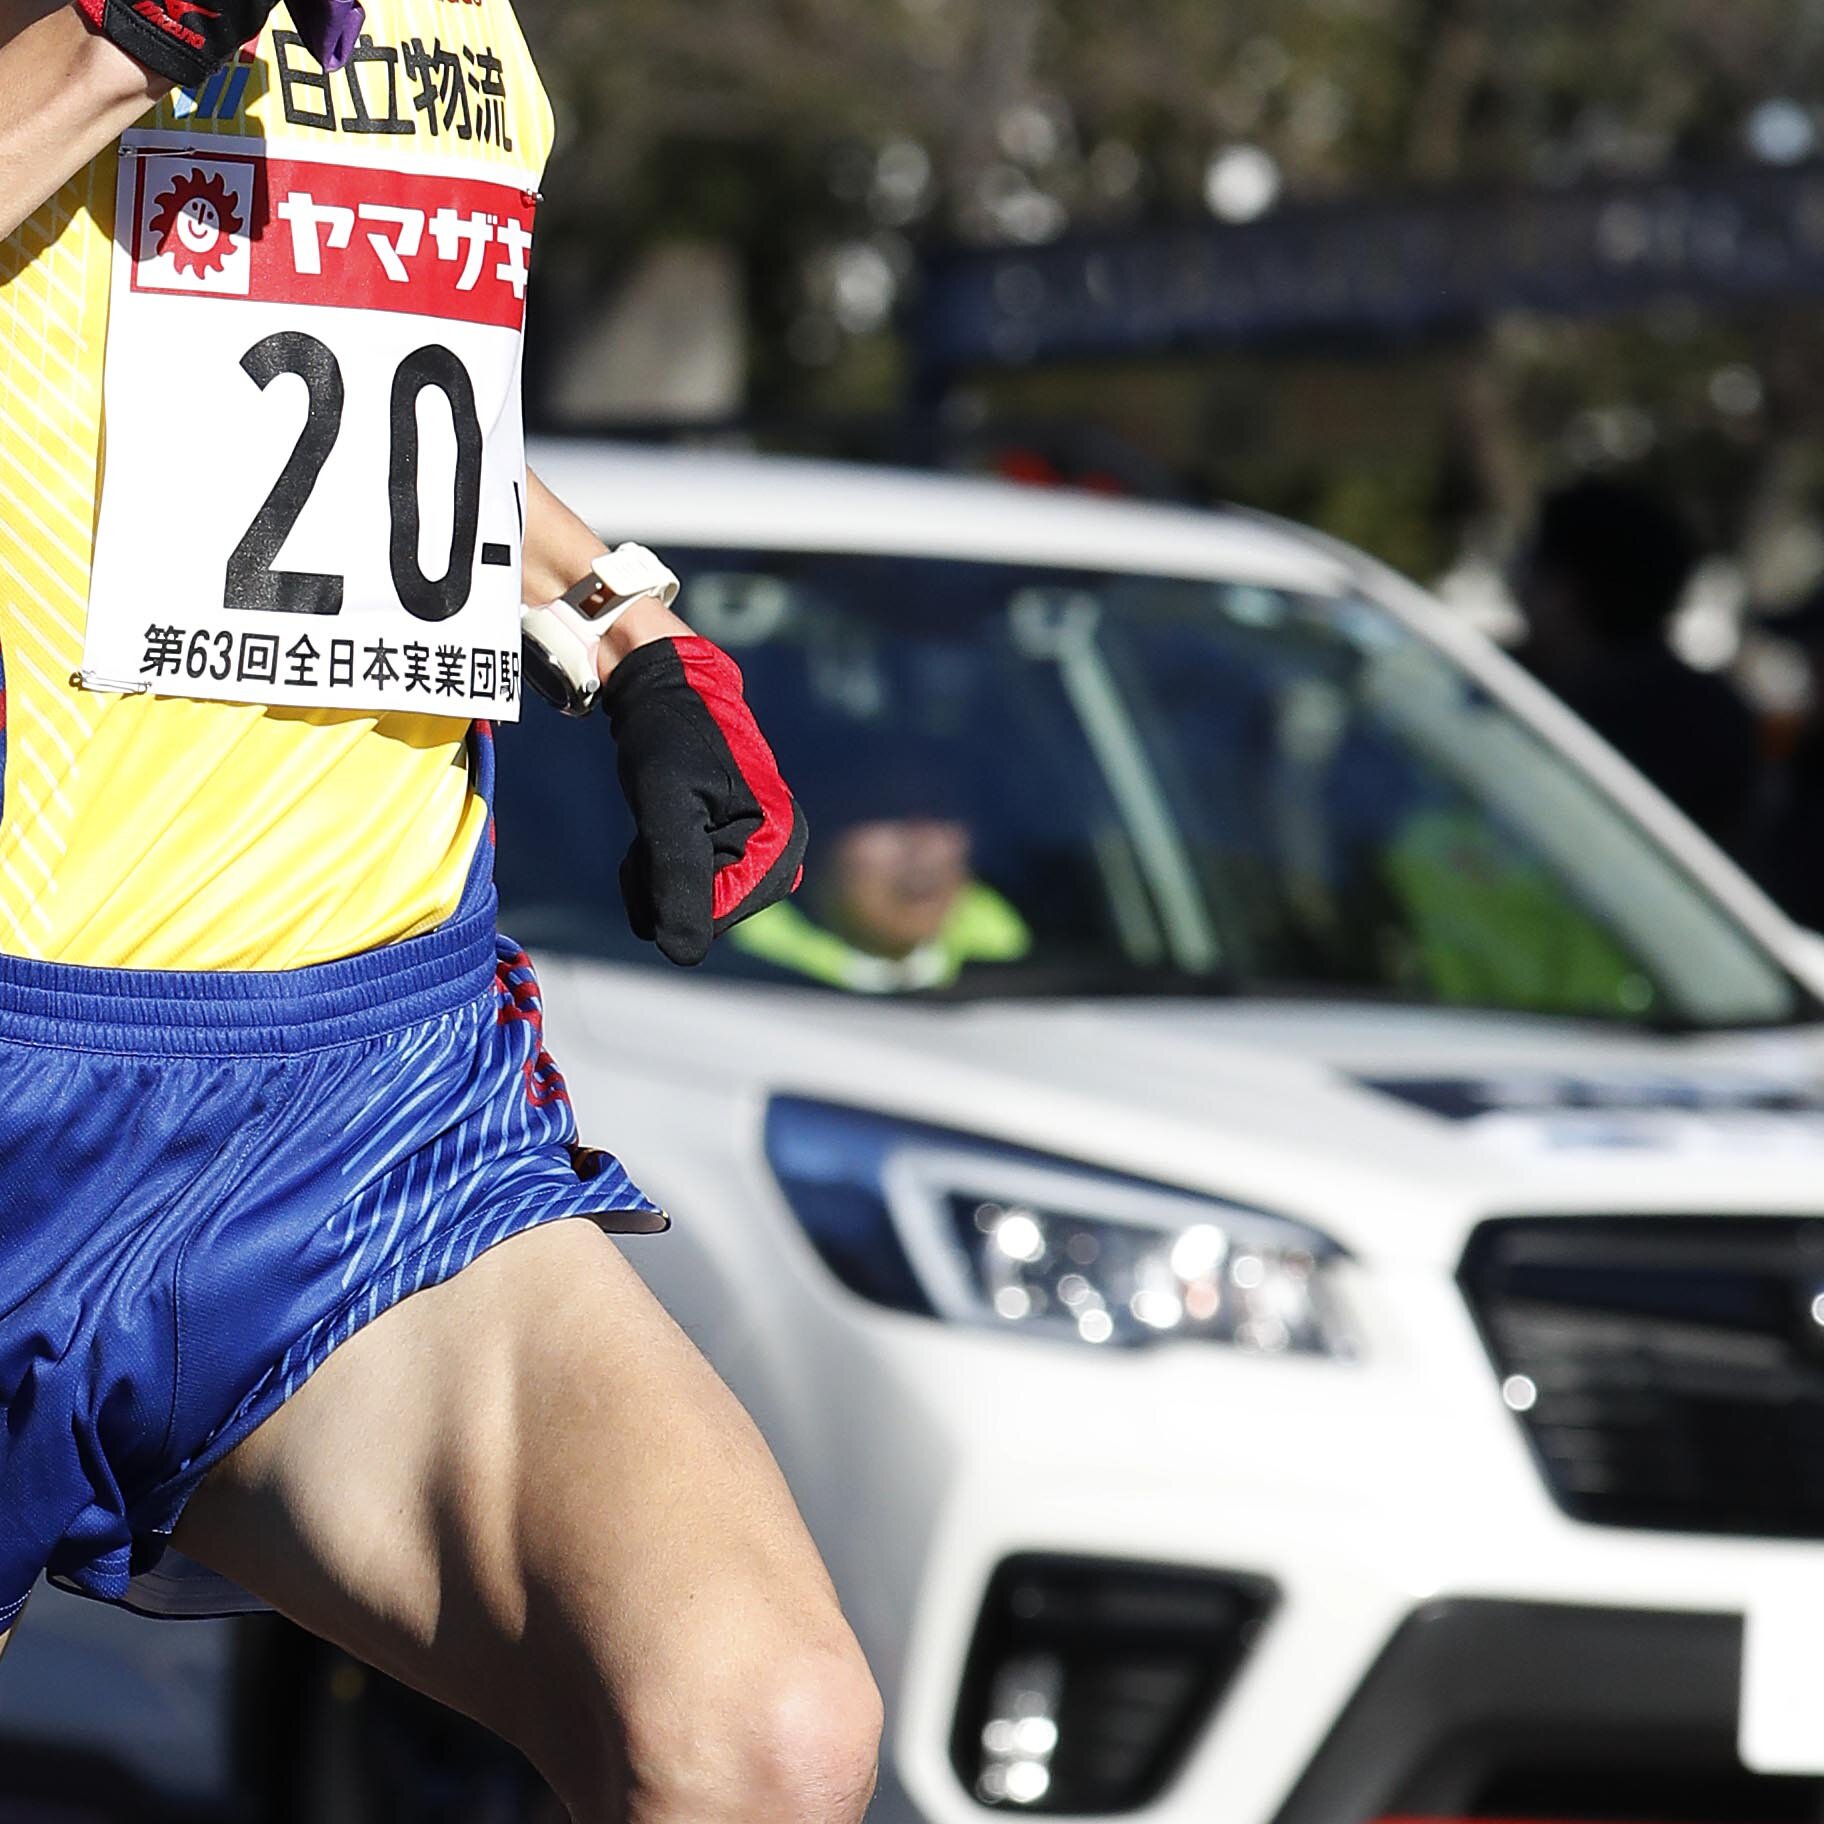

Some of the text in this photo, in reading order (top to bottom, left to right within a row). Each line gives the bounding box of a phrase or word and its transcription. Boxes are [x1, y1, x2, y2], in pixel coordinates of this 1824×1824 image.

[272, 29, 512, 153] 日立物流
[277, 192, 533, 300] ヤマザキ
[222, 330, 523, 623] 20-
[139, 623, 521, 702] 第63回全日本実業団駅
